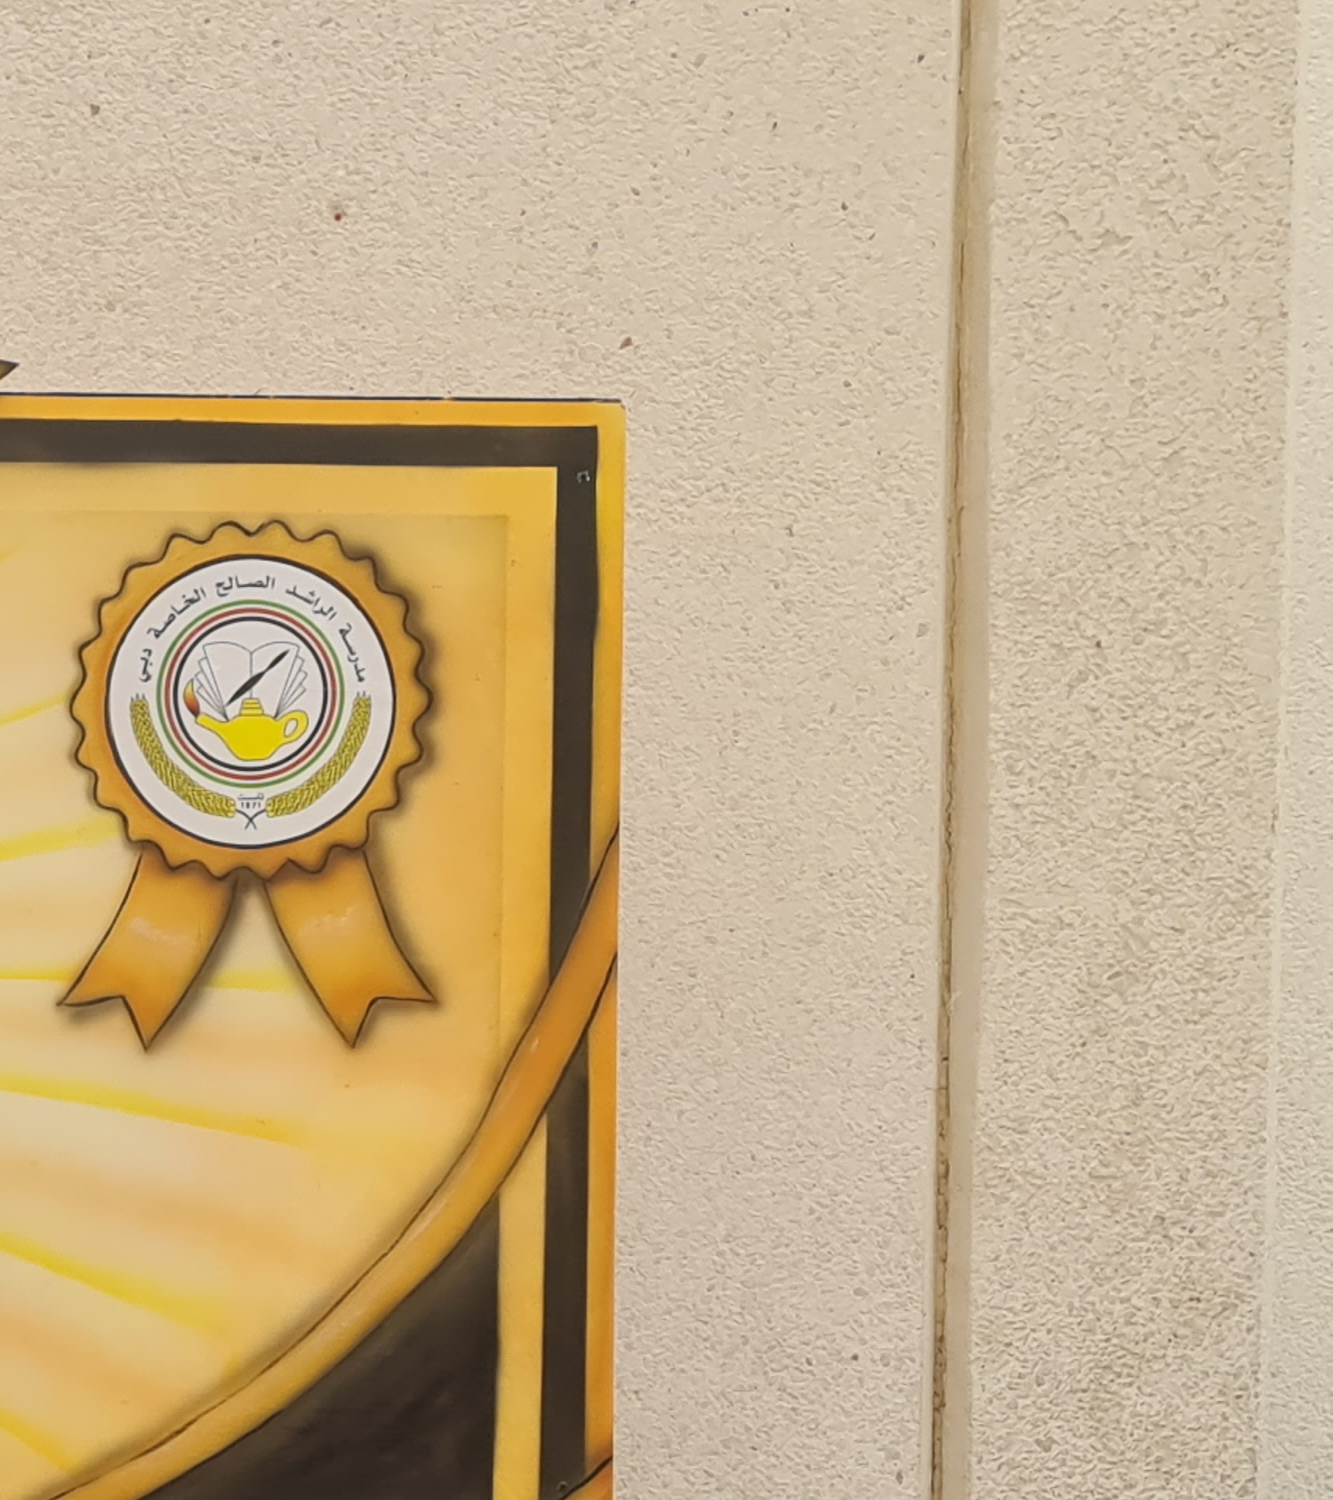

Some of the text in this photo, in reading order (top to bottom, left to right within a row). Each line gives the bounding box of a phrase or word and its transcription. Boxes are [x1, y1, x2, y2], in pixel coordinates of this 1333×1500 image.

[215, 575, 276, 598] الصالح
[285, 585, 338, 621] الراشد
[146, 586, 207, 639] الخاصة
[338, 622, 366, 683] مدرسة
